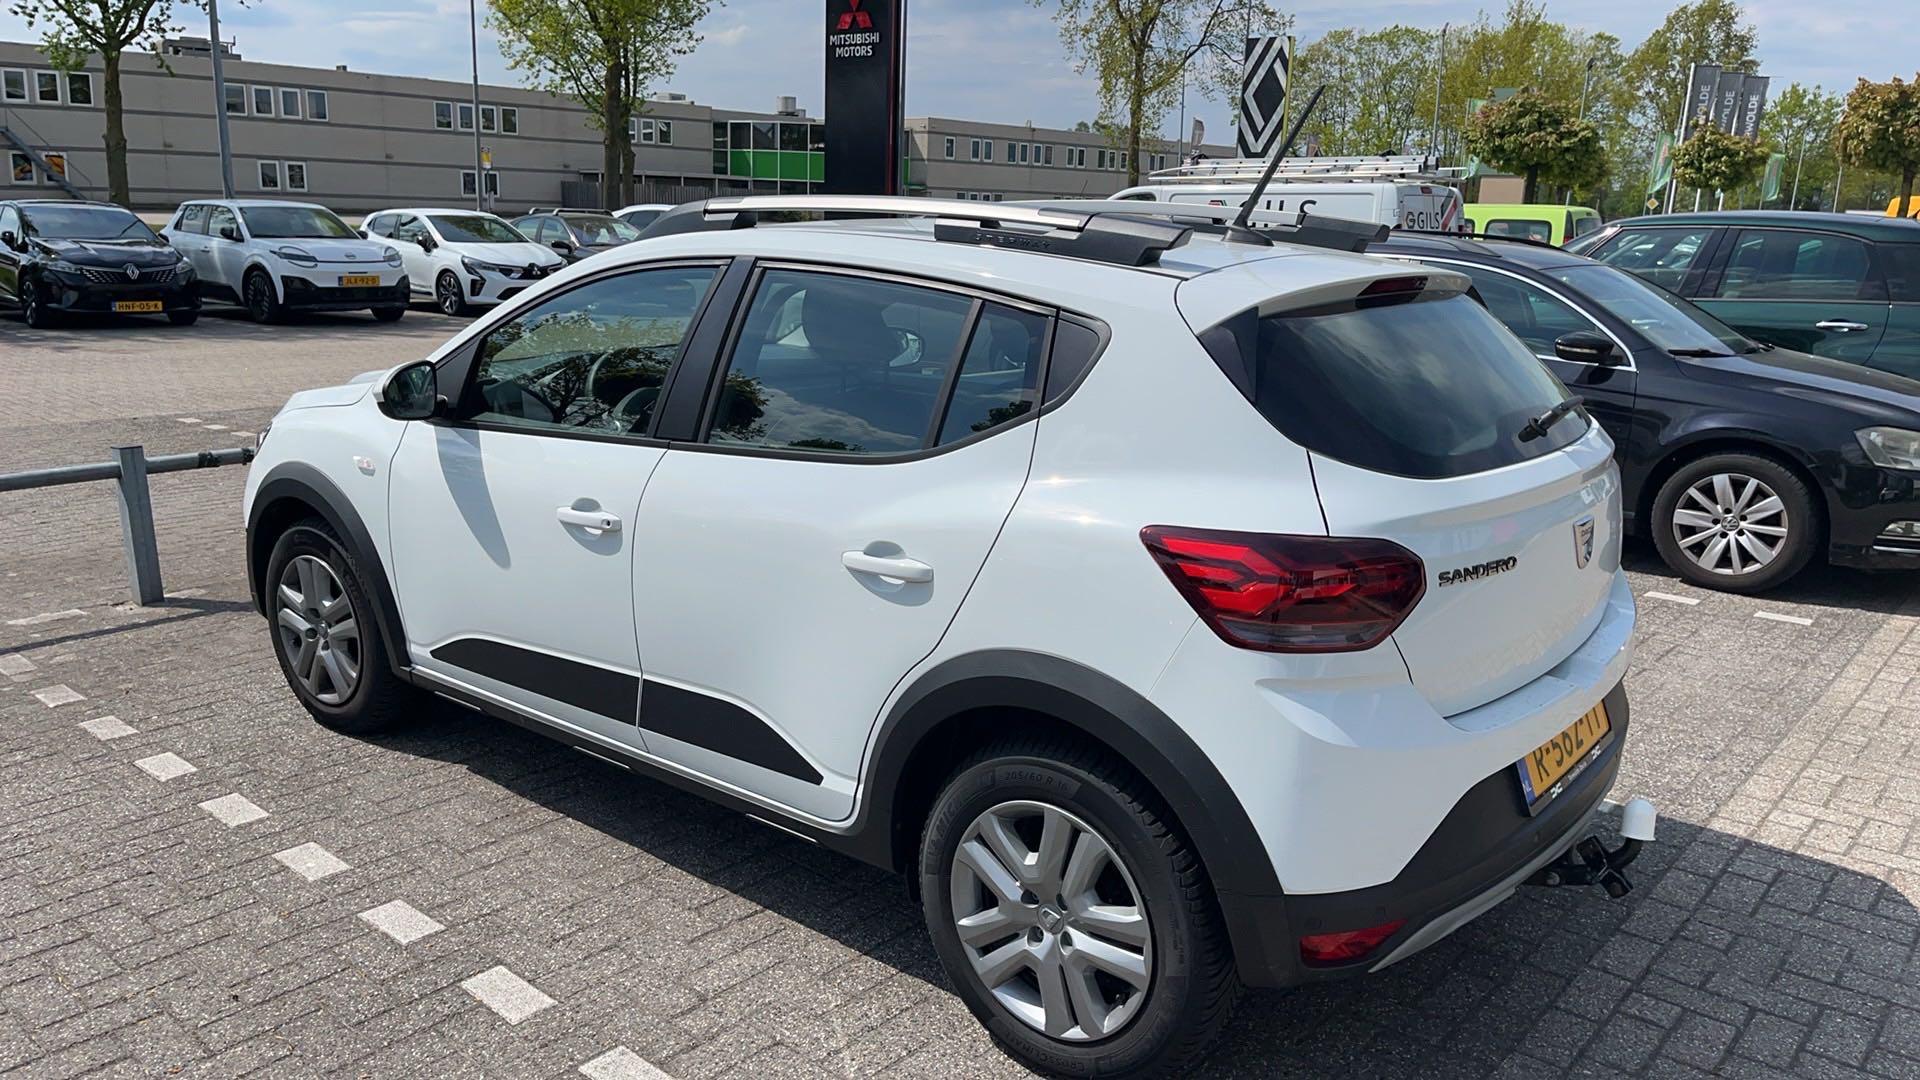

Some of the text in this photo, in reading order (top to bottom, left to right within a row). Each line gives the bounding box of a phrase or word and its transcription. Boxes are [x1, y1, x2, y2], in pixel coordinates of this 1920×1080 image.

[830, 32, 880, 46] MITSUBISHI
[835, 45, 873, 58] MOTORS
[1417, 212, 1440, 230] GILS
[1438, 556, 1518, 587] SANDERO
